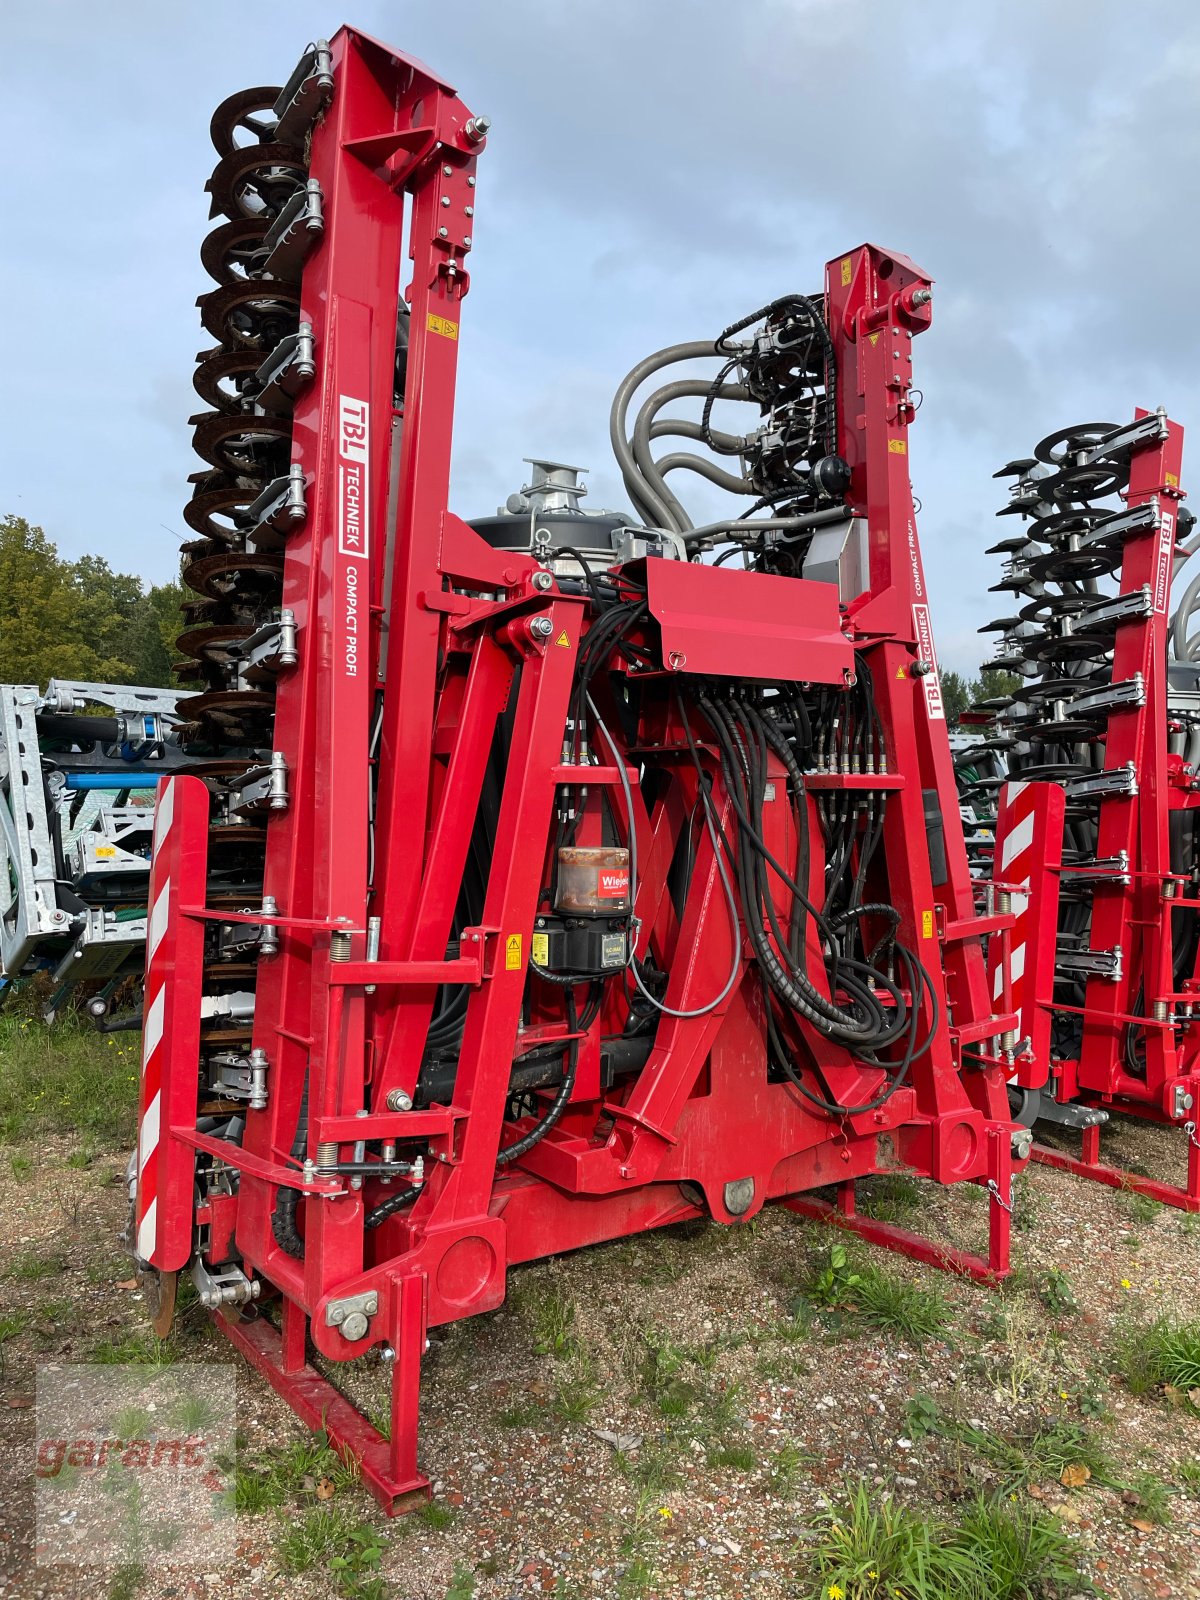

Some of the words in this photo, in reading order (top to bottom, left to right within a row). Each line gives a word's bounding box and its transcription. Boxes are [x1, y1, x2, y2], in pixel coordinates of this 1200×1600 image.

[343, 406, 366, 454] TBL
[346, 466, 360, 547] TECHNIEK
[1160, 518, 1172, 549] TBL
[908, 548, 923, 597] COMPACT
[1156, 556, 1167, 607] TECHNIEK
[345, 566, 358, 634] COMPACT
[345, 635, 357, 677] PROFI
[918, 611, 933, 667] ECHNIEK
[926, 677, 941, 715] TBL
